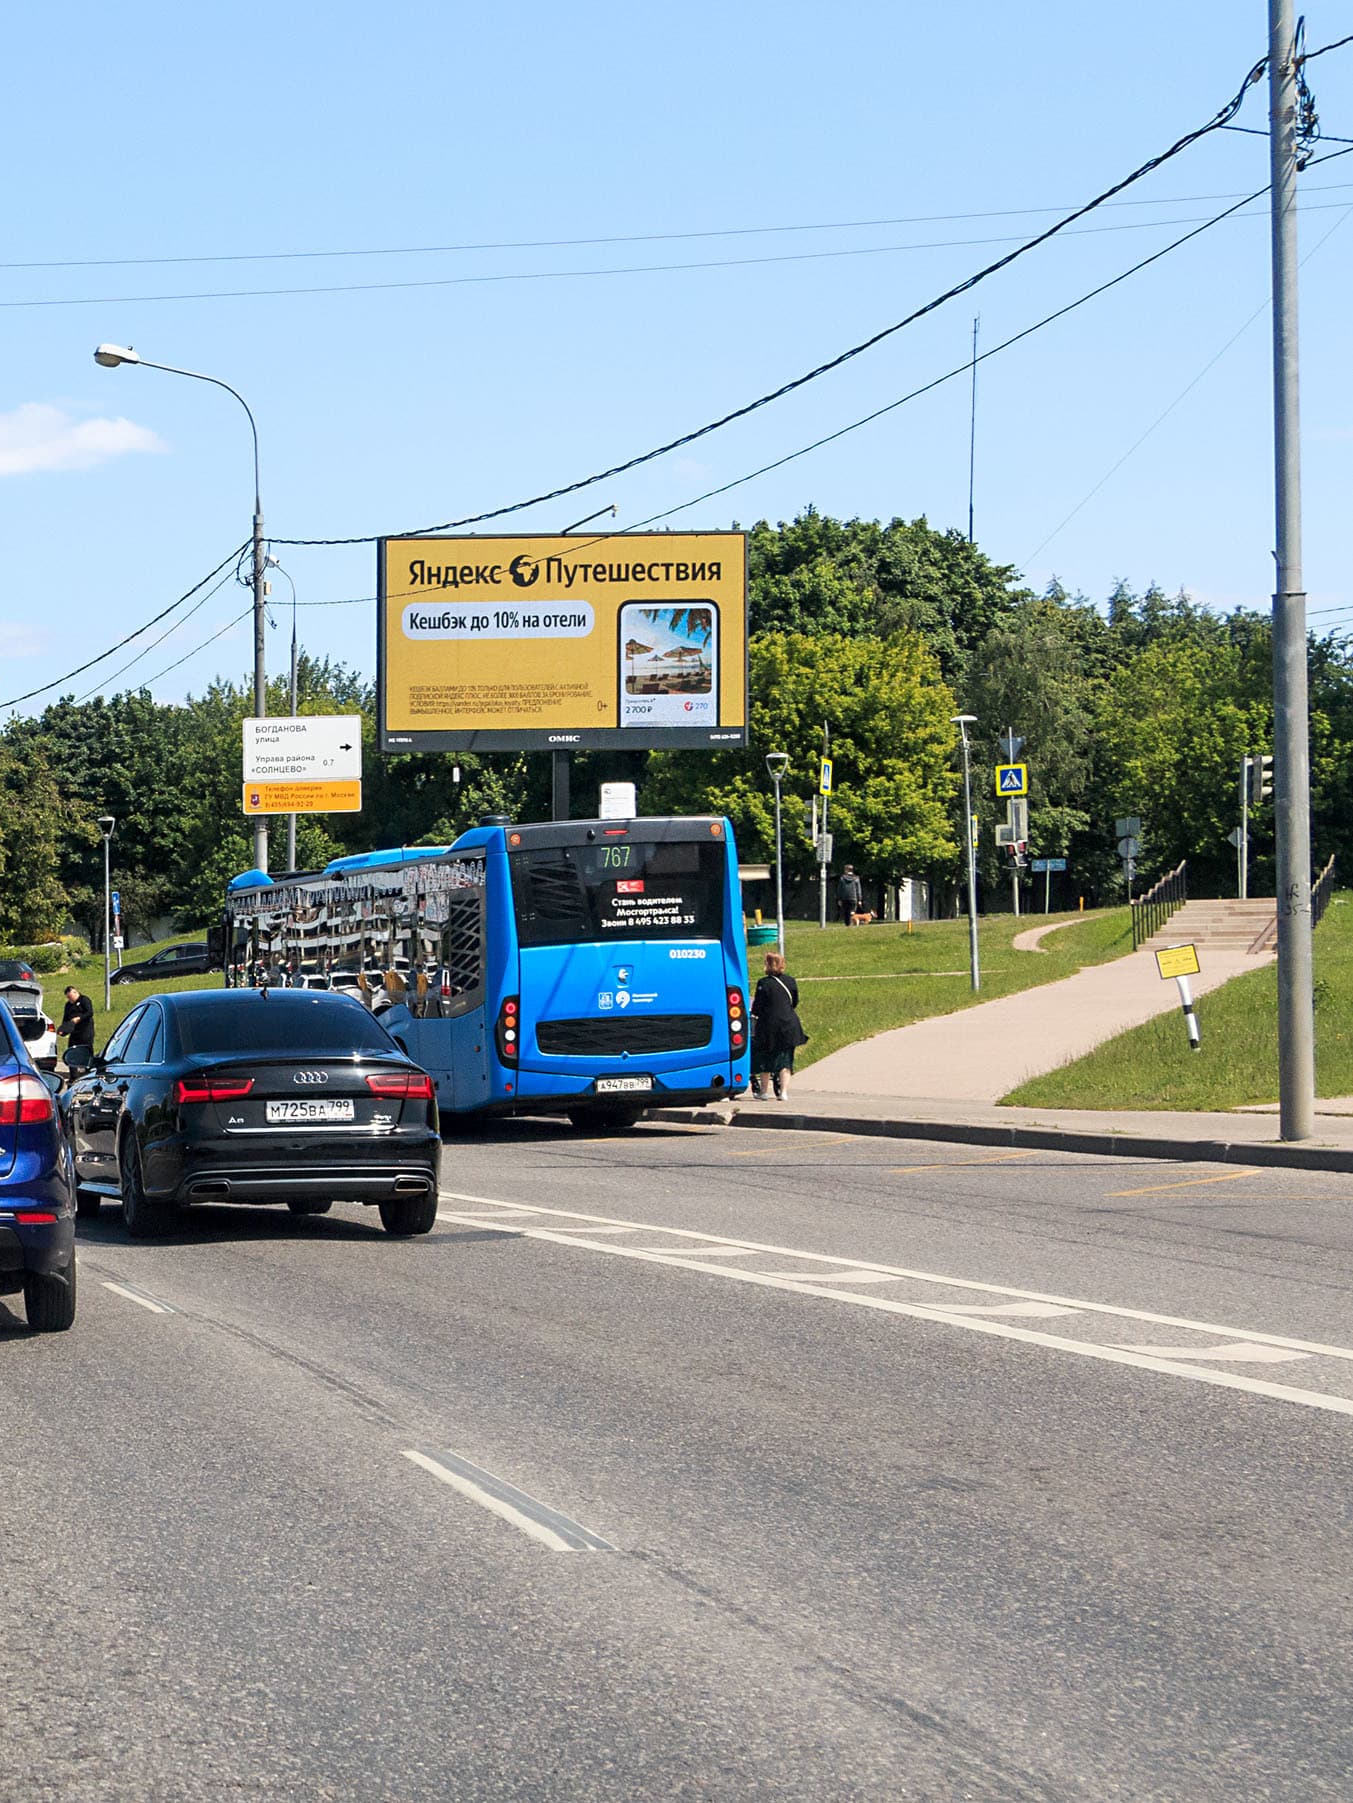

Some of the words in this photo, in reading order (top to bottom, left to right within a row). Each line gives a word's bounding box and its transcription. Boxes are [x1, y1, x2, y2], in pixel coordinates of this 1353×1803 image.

[410, 560, 502, 588] Яндекс
[546, 558, 722, 588] Путешествия
[410, 612, 466, 631] Кешбэк
[471, 615, 490, 632] до
[494, 611, 520, 628] 10%
[522, 614, 540, 628] на
[543, 614, 586, 628] отели
[597, 700, 608, 712] 0+
[256, 725, 307, 734] БОГДАНОВА
[548, 735, 581, 744] ОМИС
[286, 755, 315, 763] района
[252, 766, 306, 774] «СОЛНЦЕВО»
[601, 846, 630, 868] 767
[612, 898, 636, 906] Стань
[637, 898, 682, 906] водителем
[616, 906, 679, 916] Мосгортранса!
[601, 919, 626, 928] Звони
[653, 916, 669, 925] 423
[684, 915, 695, 923] 33
[670, 950, 706, 959] 010230
[271, 1102, 326, 1117] М725ВА
[328, 1101, 350, 1112] 799
